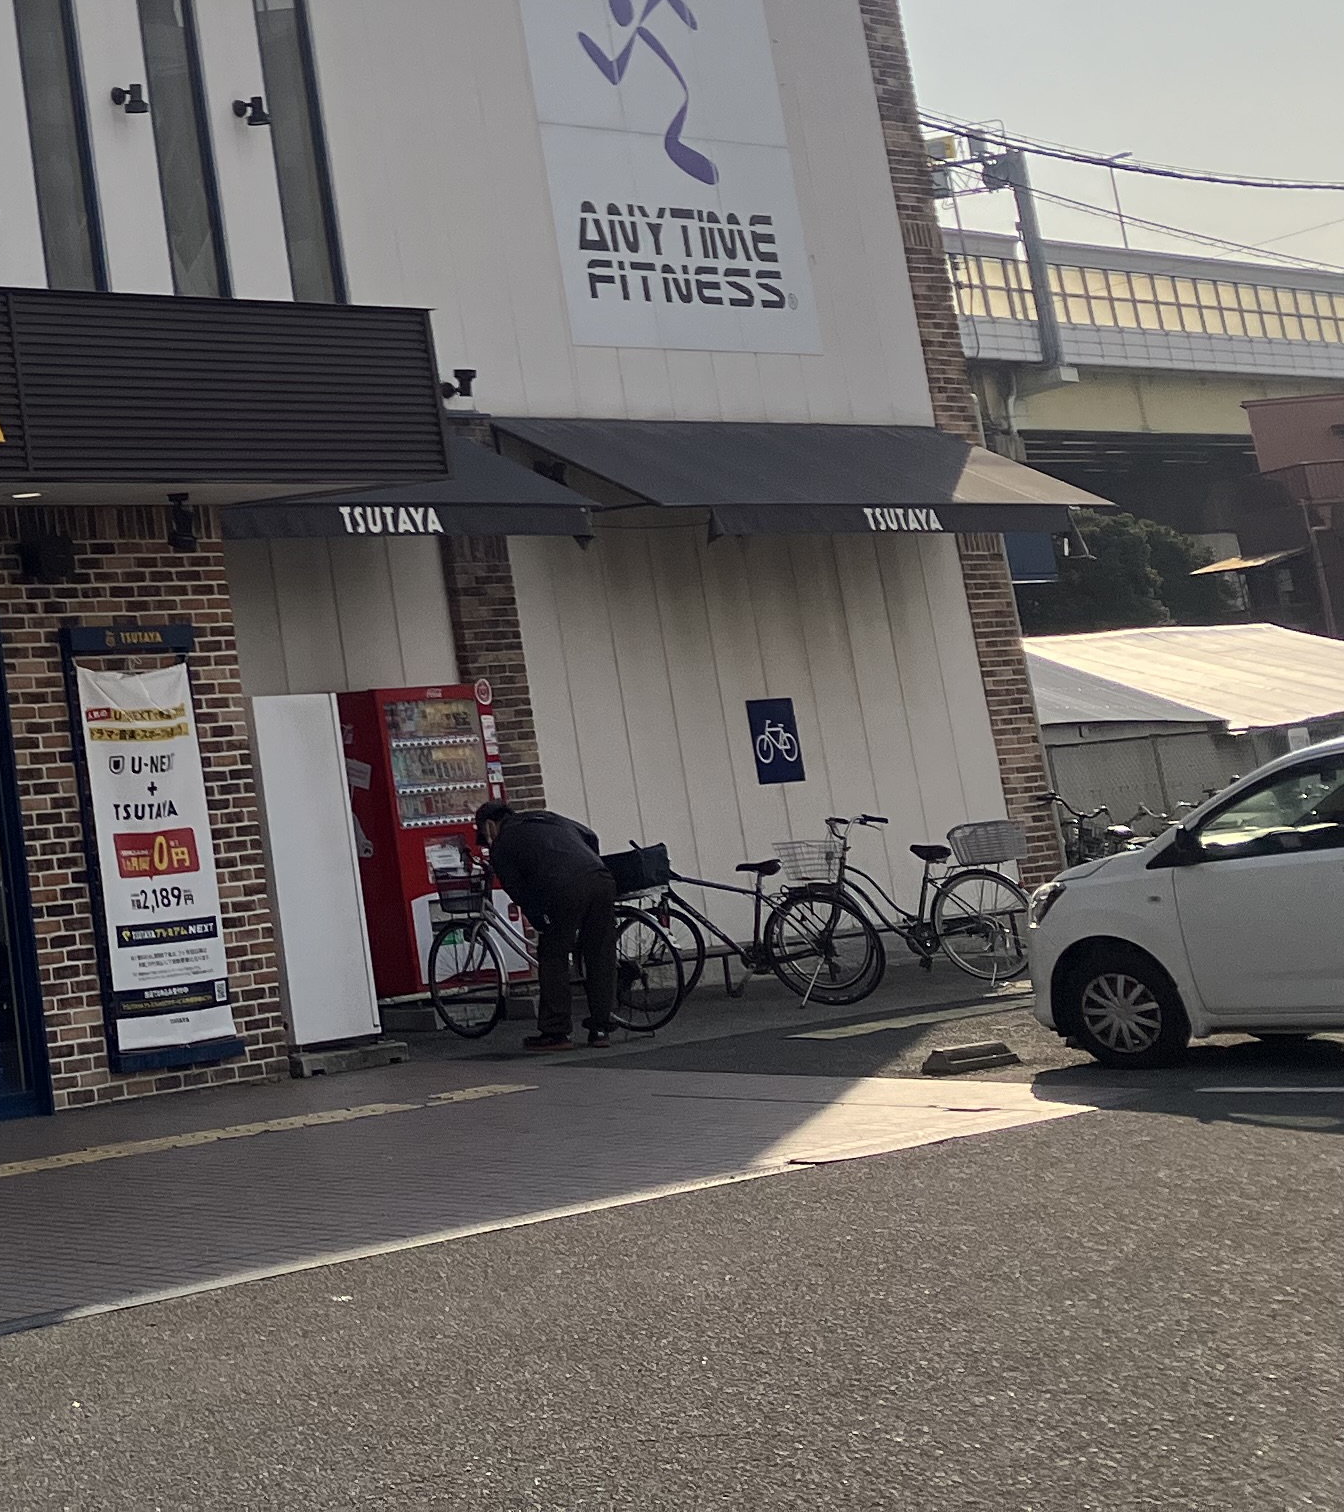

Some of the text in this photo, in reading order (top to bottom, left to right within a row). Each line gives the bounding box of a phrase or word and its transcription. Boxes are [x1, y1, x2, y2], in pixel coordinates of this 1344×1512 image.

[579, 200, 779, 263] ANYTIME
[587, 259, 787, 310] FITNESS
[338, 505, 445, 534] TSUTAYA
[863, 507, 944, 532] TSUTAYA
[119, 631, 163, 645] TSUTAYA
[130, 752, 175, 774] U-NEXT
[113, 800, 179, 821] TSUTAYA
